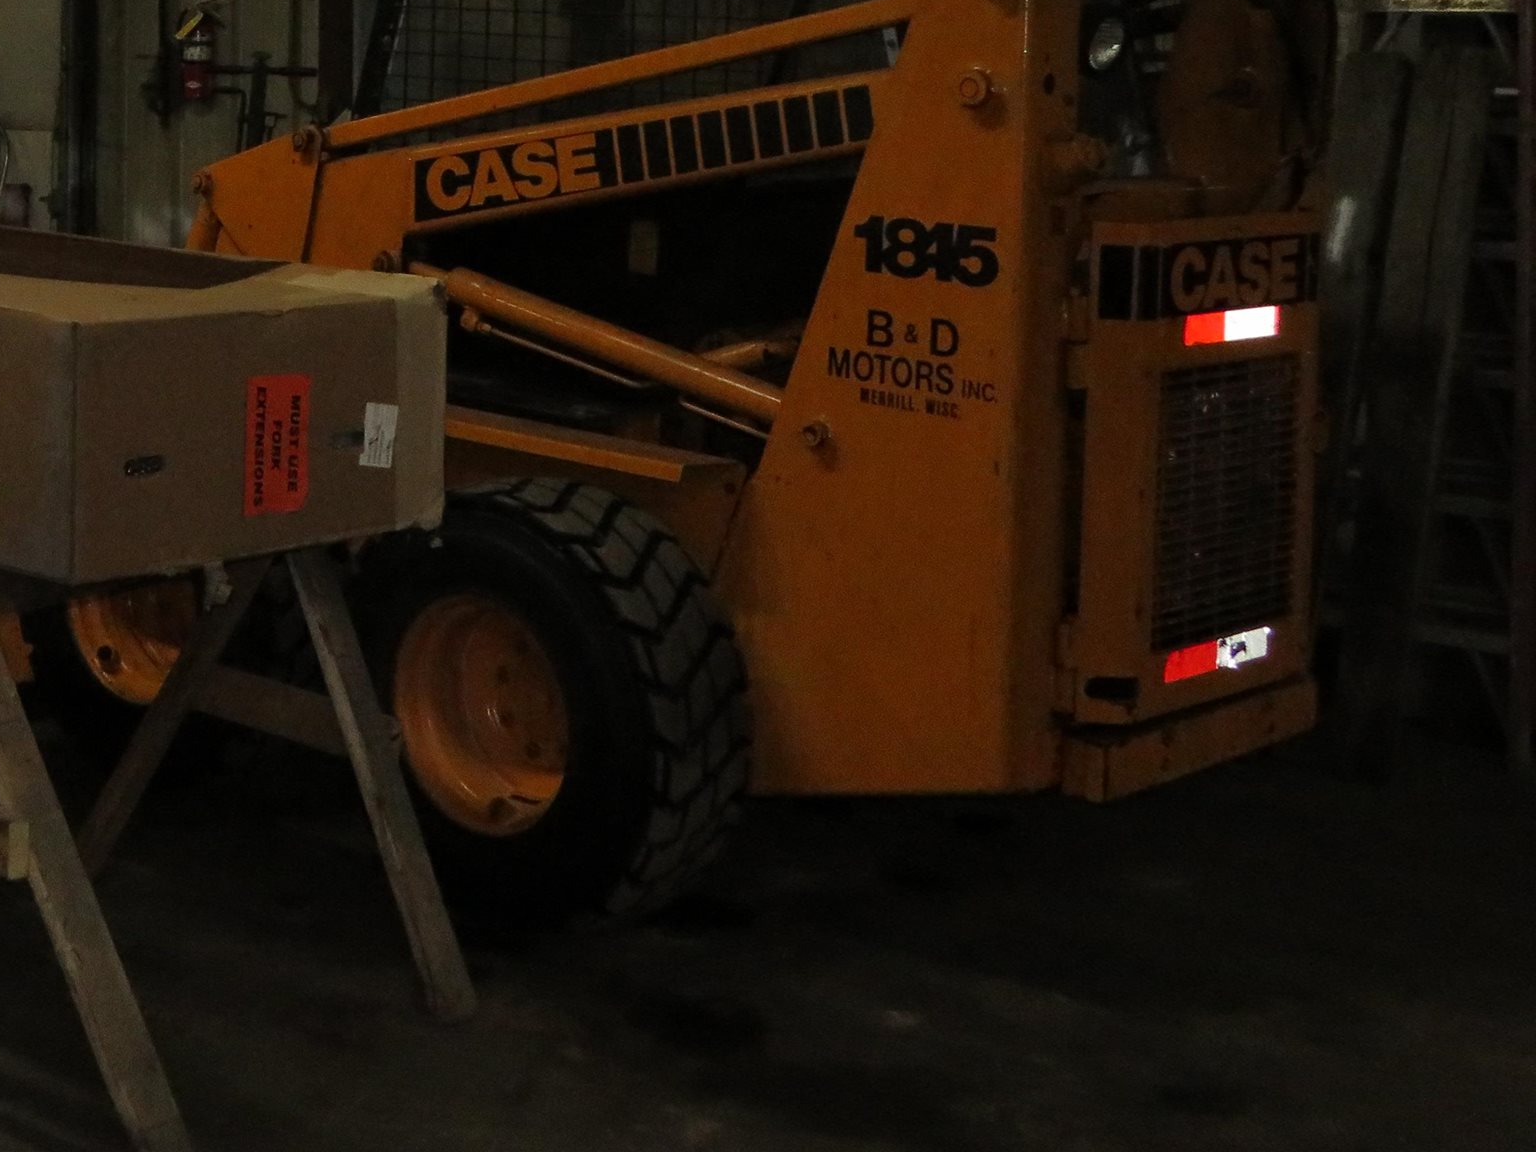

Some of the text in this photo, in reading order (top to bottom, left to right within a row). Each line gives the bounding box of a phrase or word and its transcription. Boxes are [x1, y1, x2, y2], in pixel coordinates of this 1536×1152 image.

[425, 132, 602, 212] CASE
[854, 215, 999, 287] 1845
[1170, 237, 1300, 313] CASE
[866, 309, 960, 357] B & D
[827, 346, 954, 395] MOTORS
[253, 386, 268, 507] EXTENSIONS
[271, 420, 283, 471] FORK
[287, 394, 302, 493] MUST USE
